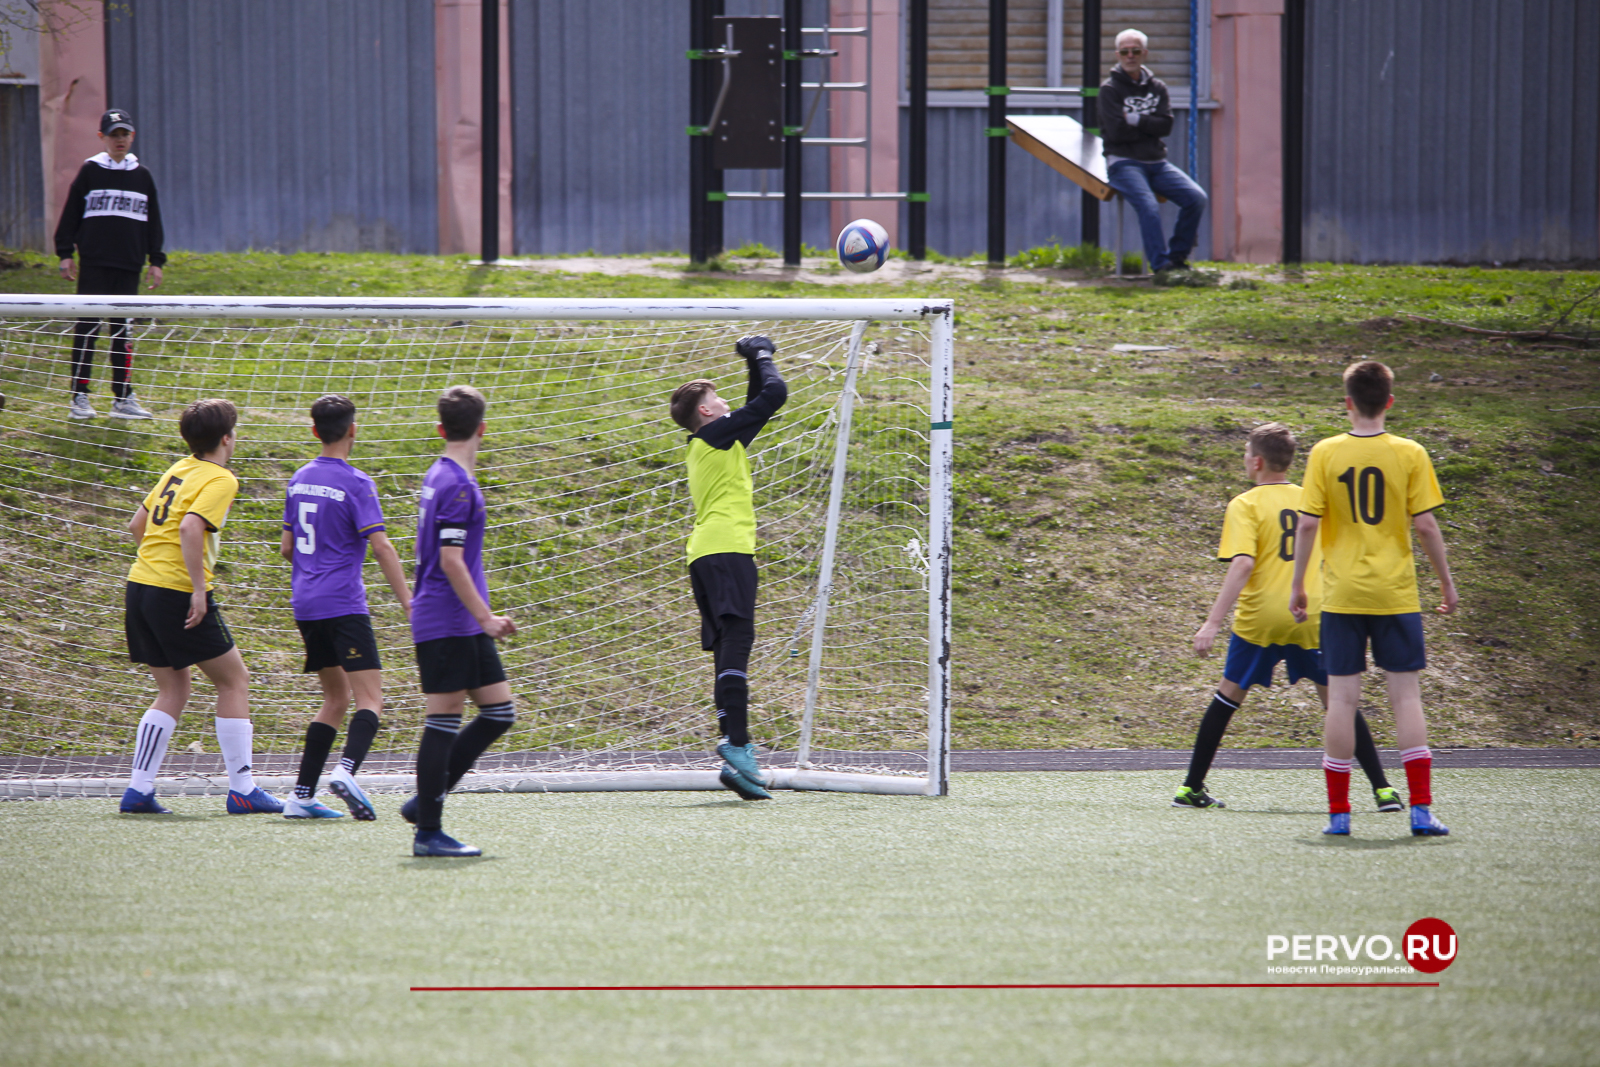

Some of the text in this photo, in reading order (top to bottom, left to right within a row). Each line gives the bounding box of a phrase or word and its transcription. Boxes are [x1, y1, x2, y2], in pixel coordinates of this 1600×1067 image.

[111, 196, 131, 212] FOR
[152, 475, 184, 526] 5
[1338, 466, 1385, 525] 10
[296, 501, 319, 555] 5
[1279, 508, 1299, 562] 8
